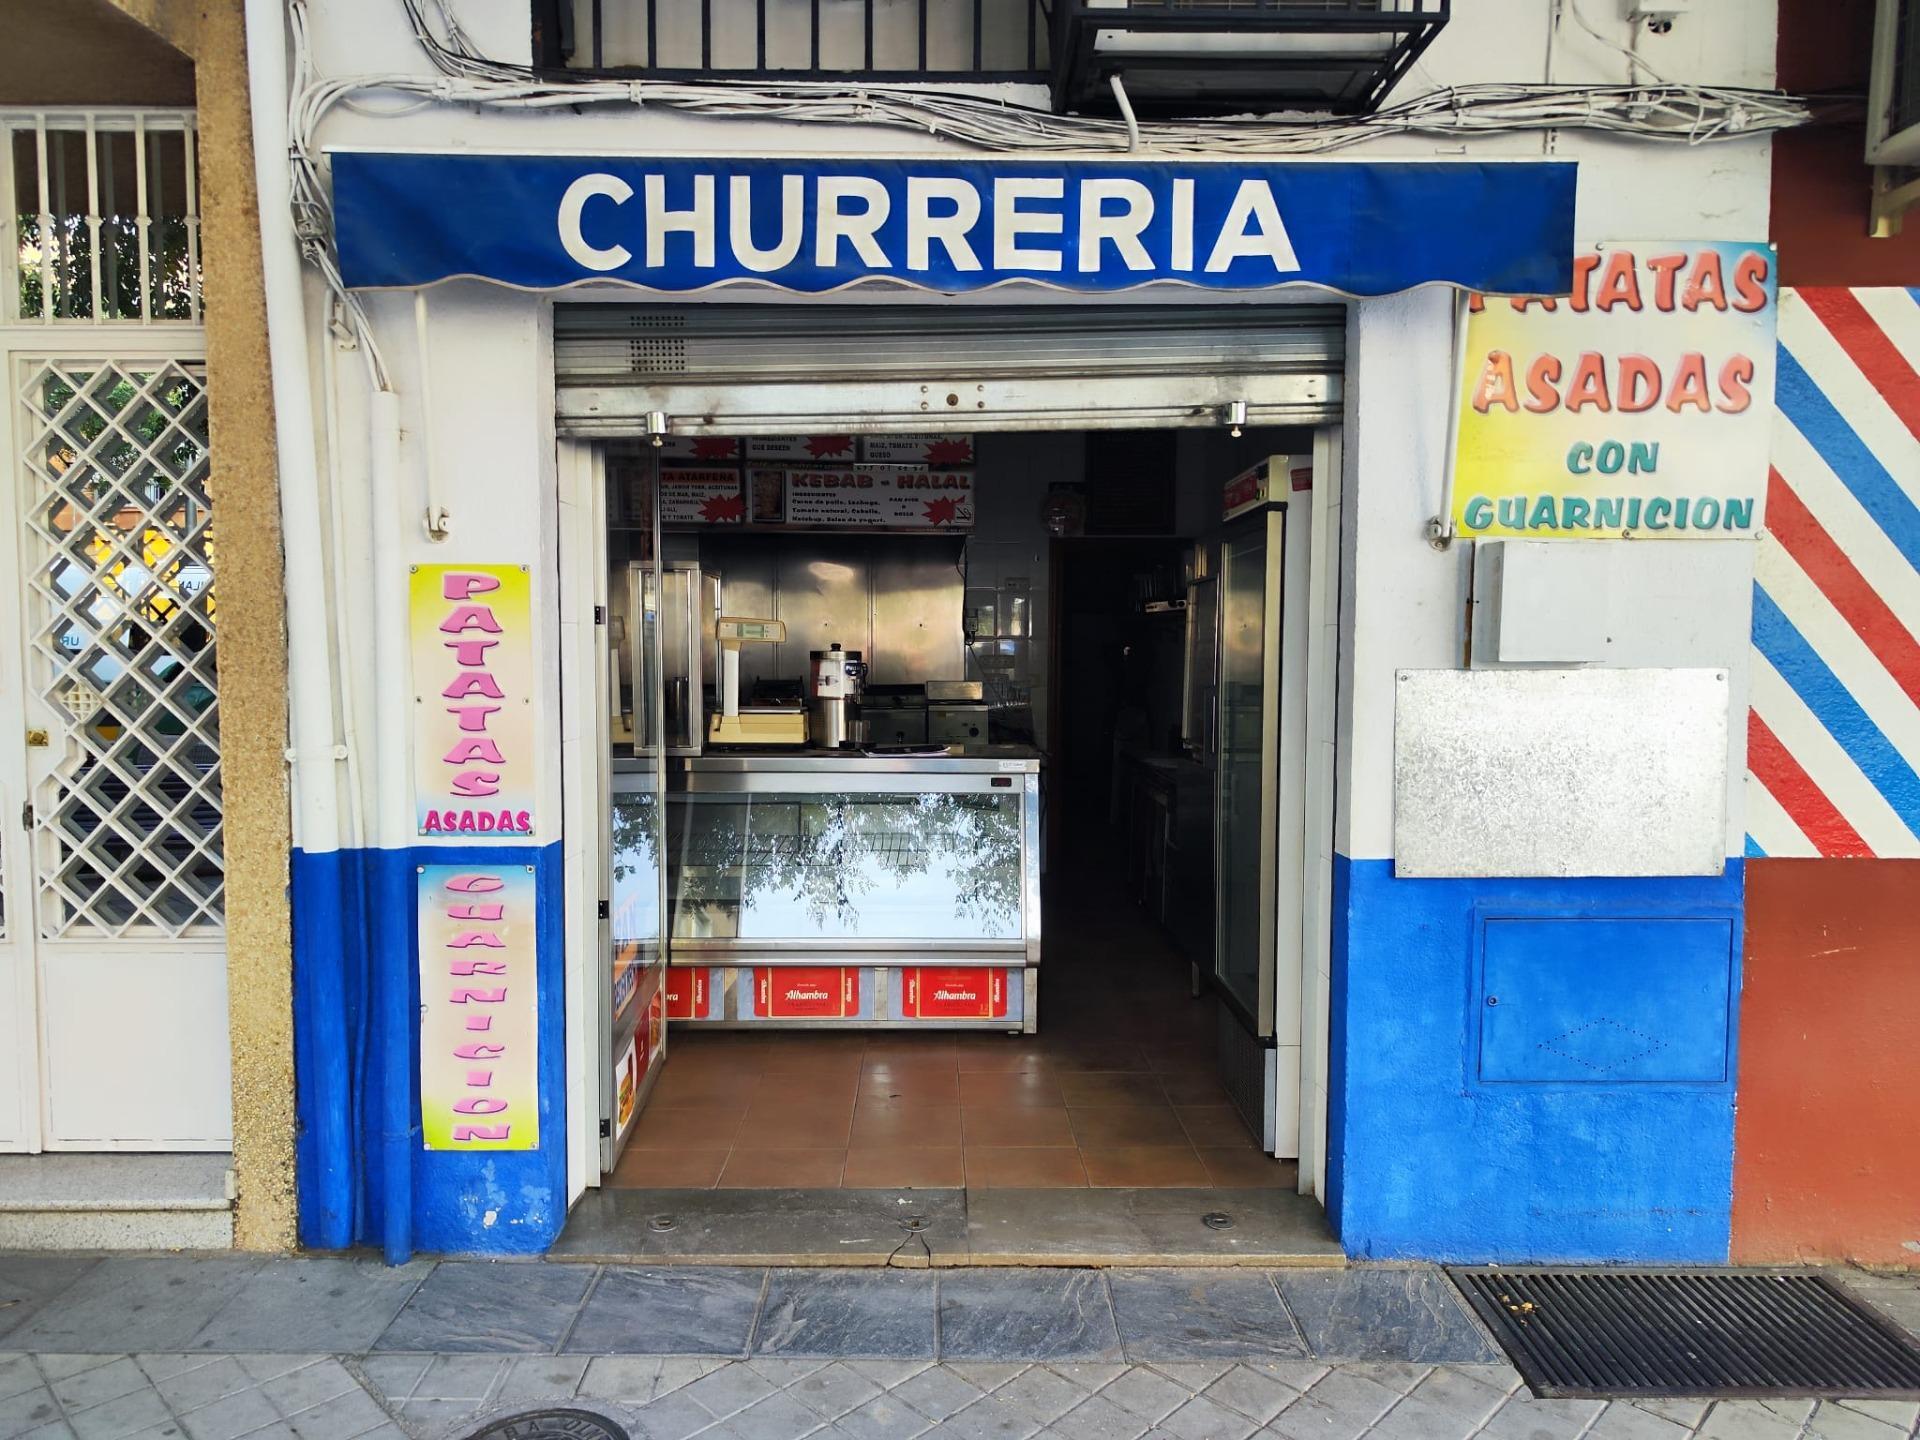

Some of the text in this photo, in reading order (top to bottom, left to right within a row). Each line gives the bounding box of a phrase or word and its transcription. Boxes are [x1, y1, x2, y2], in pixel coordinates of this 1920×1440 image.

[558, 173, 1301, 273] CHURRERIA
[1469, 250, 1768, 313] TATAS
[1472, 351, 1754, 414] ASADAS
[1566, 440, 1659, 474] CON
[792, 473, 874, 488] KEBAB
[897, 474, 970, 489] HALAL
[1464, 496, 1754, 531] GUARNICION
[439, 573, 506, 797] PATATAS
[424, 809, 532, 833] ASADAS
[445, 874, 511, 1140] GUARNICION
[784, 989, 829, 1001] Alhambra
[933, 989, 977, 1001] Alhambra
